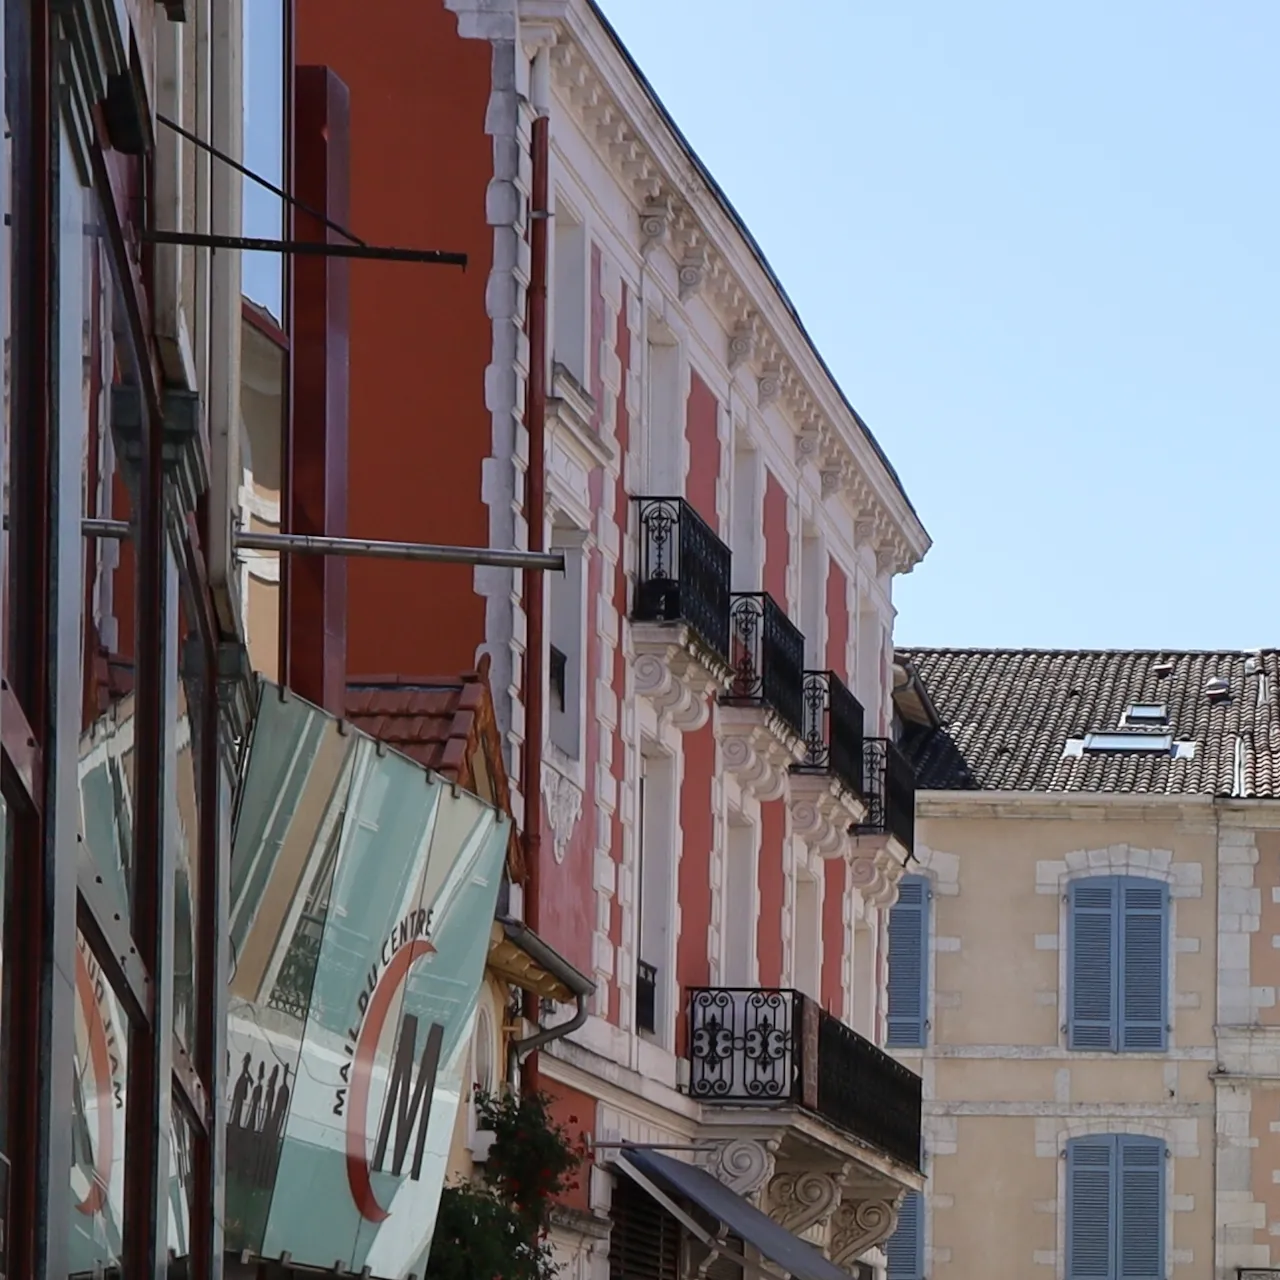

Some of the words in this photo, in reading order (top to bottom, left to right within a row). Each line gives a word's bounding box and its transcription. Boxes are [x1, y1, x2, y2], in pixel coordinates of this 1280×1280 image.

[332, 1024, 361, 1117] MAIL
[357, 964, 379, 1015] DU
[380, 908, 435, 966] CENTRE
